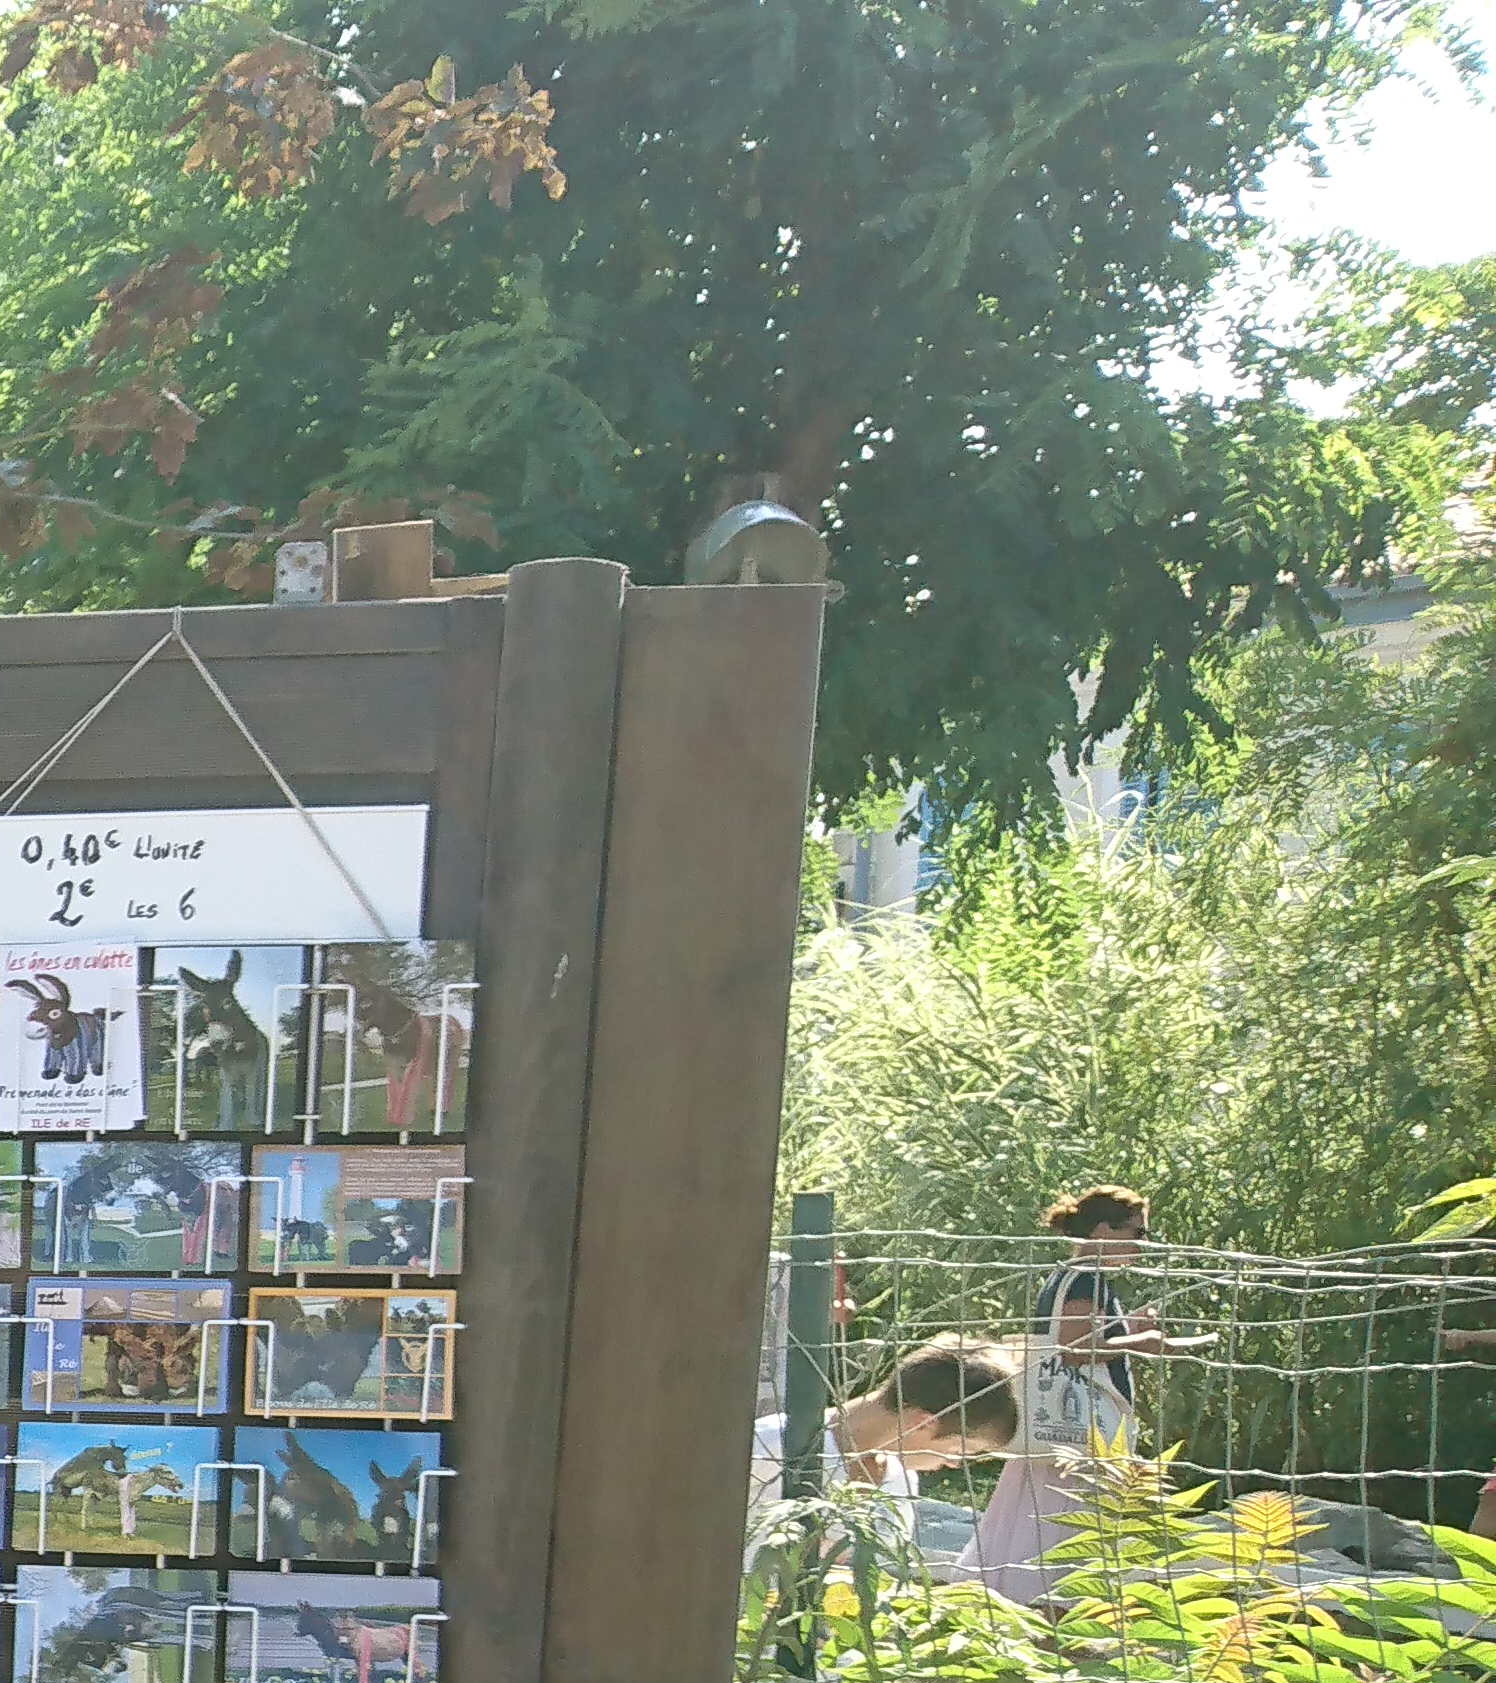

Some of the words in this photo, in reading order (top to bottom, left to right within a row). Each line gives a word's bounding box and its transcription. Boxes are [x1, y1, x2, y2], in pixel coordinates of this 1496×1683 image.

[47, 878, 96, 928] 2€
[126, 899, 159, 919] LES
[178, 887, 197, 921] 6
[62, 956, 82, 971] en
[30, 1118, 52, 1129] ILE
[55, 1118, 70, 1128] de
[74, 1117, 92, 1129] RE
